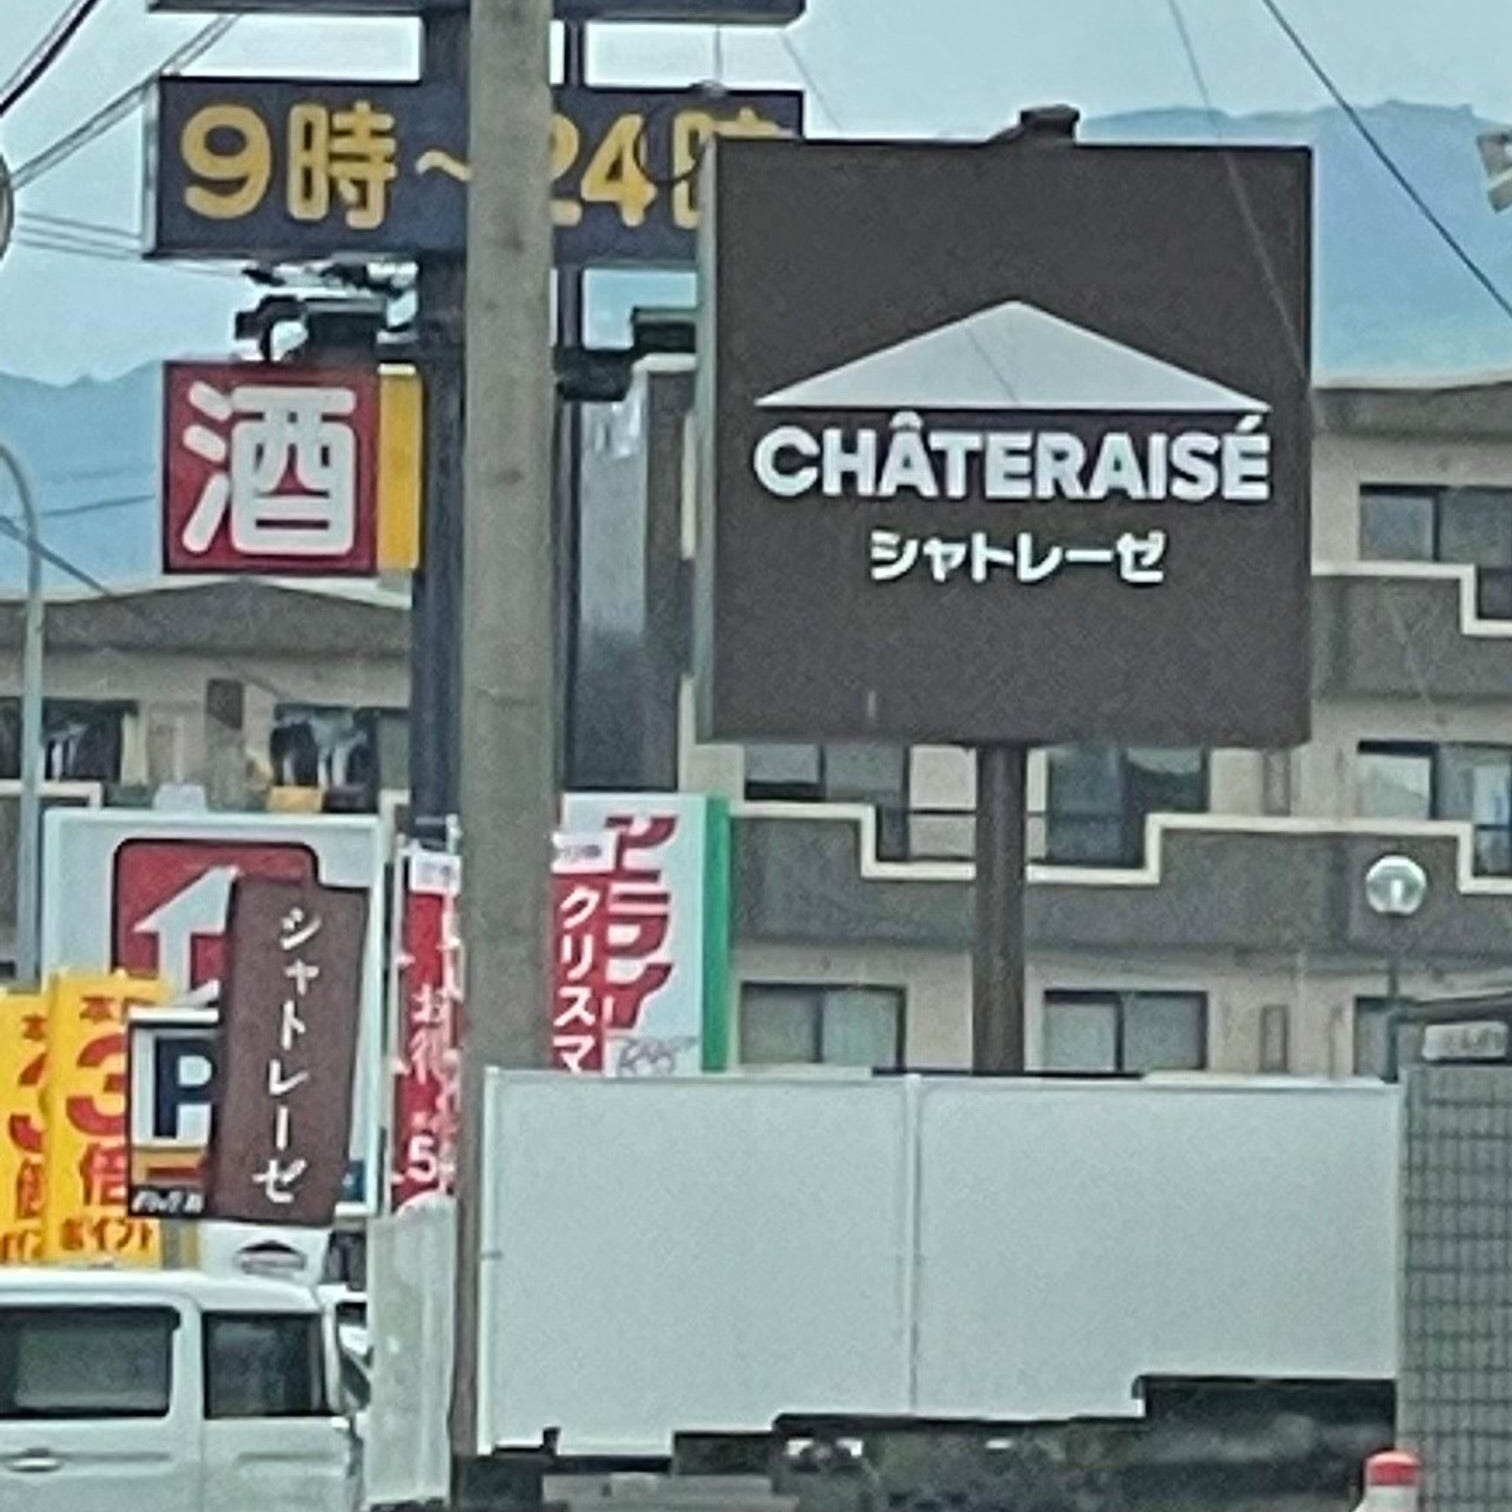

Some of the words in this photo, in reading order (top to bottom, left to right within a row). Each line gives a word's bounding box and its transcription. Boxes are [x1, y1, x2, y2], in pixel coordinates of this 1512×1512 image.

[182, 381, 356, 556] 酒
[753, 410, 1270, 500] CHÂTERAISÉ
[870, 529, 1167, 582] シャトレーゼ
[251, 907, 323, 1204] シャトレーゼ
